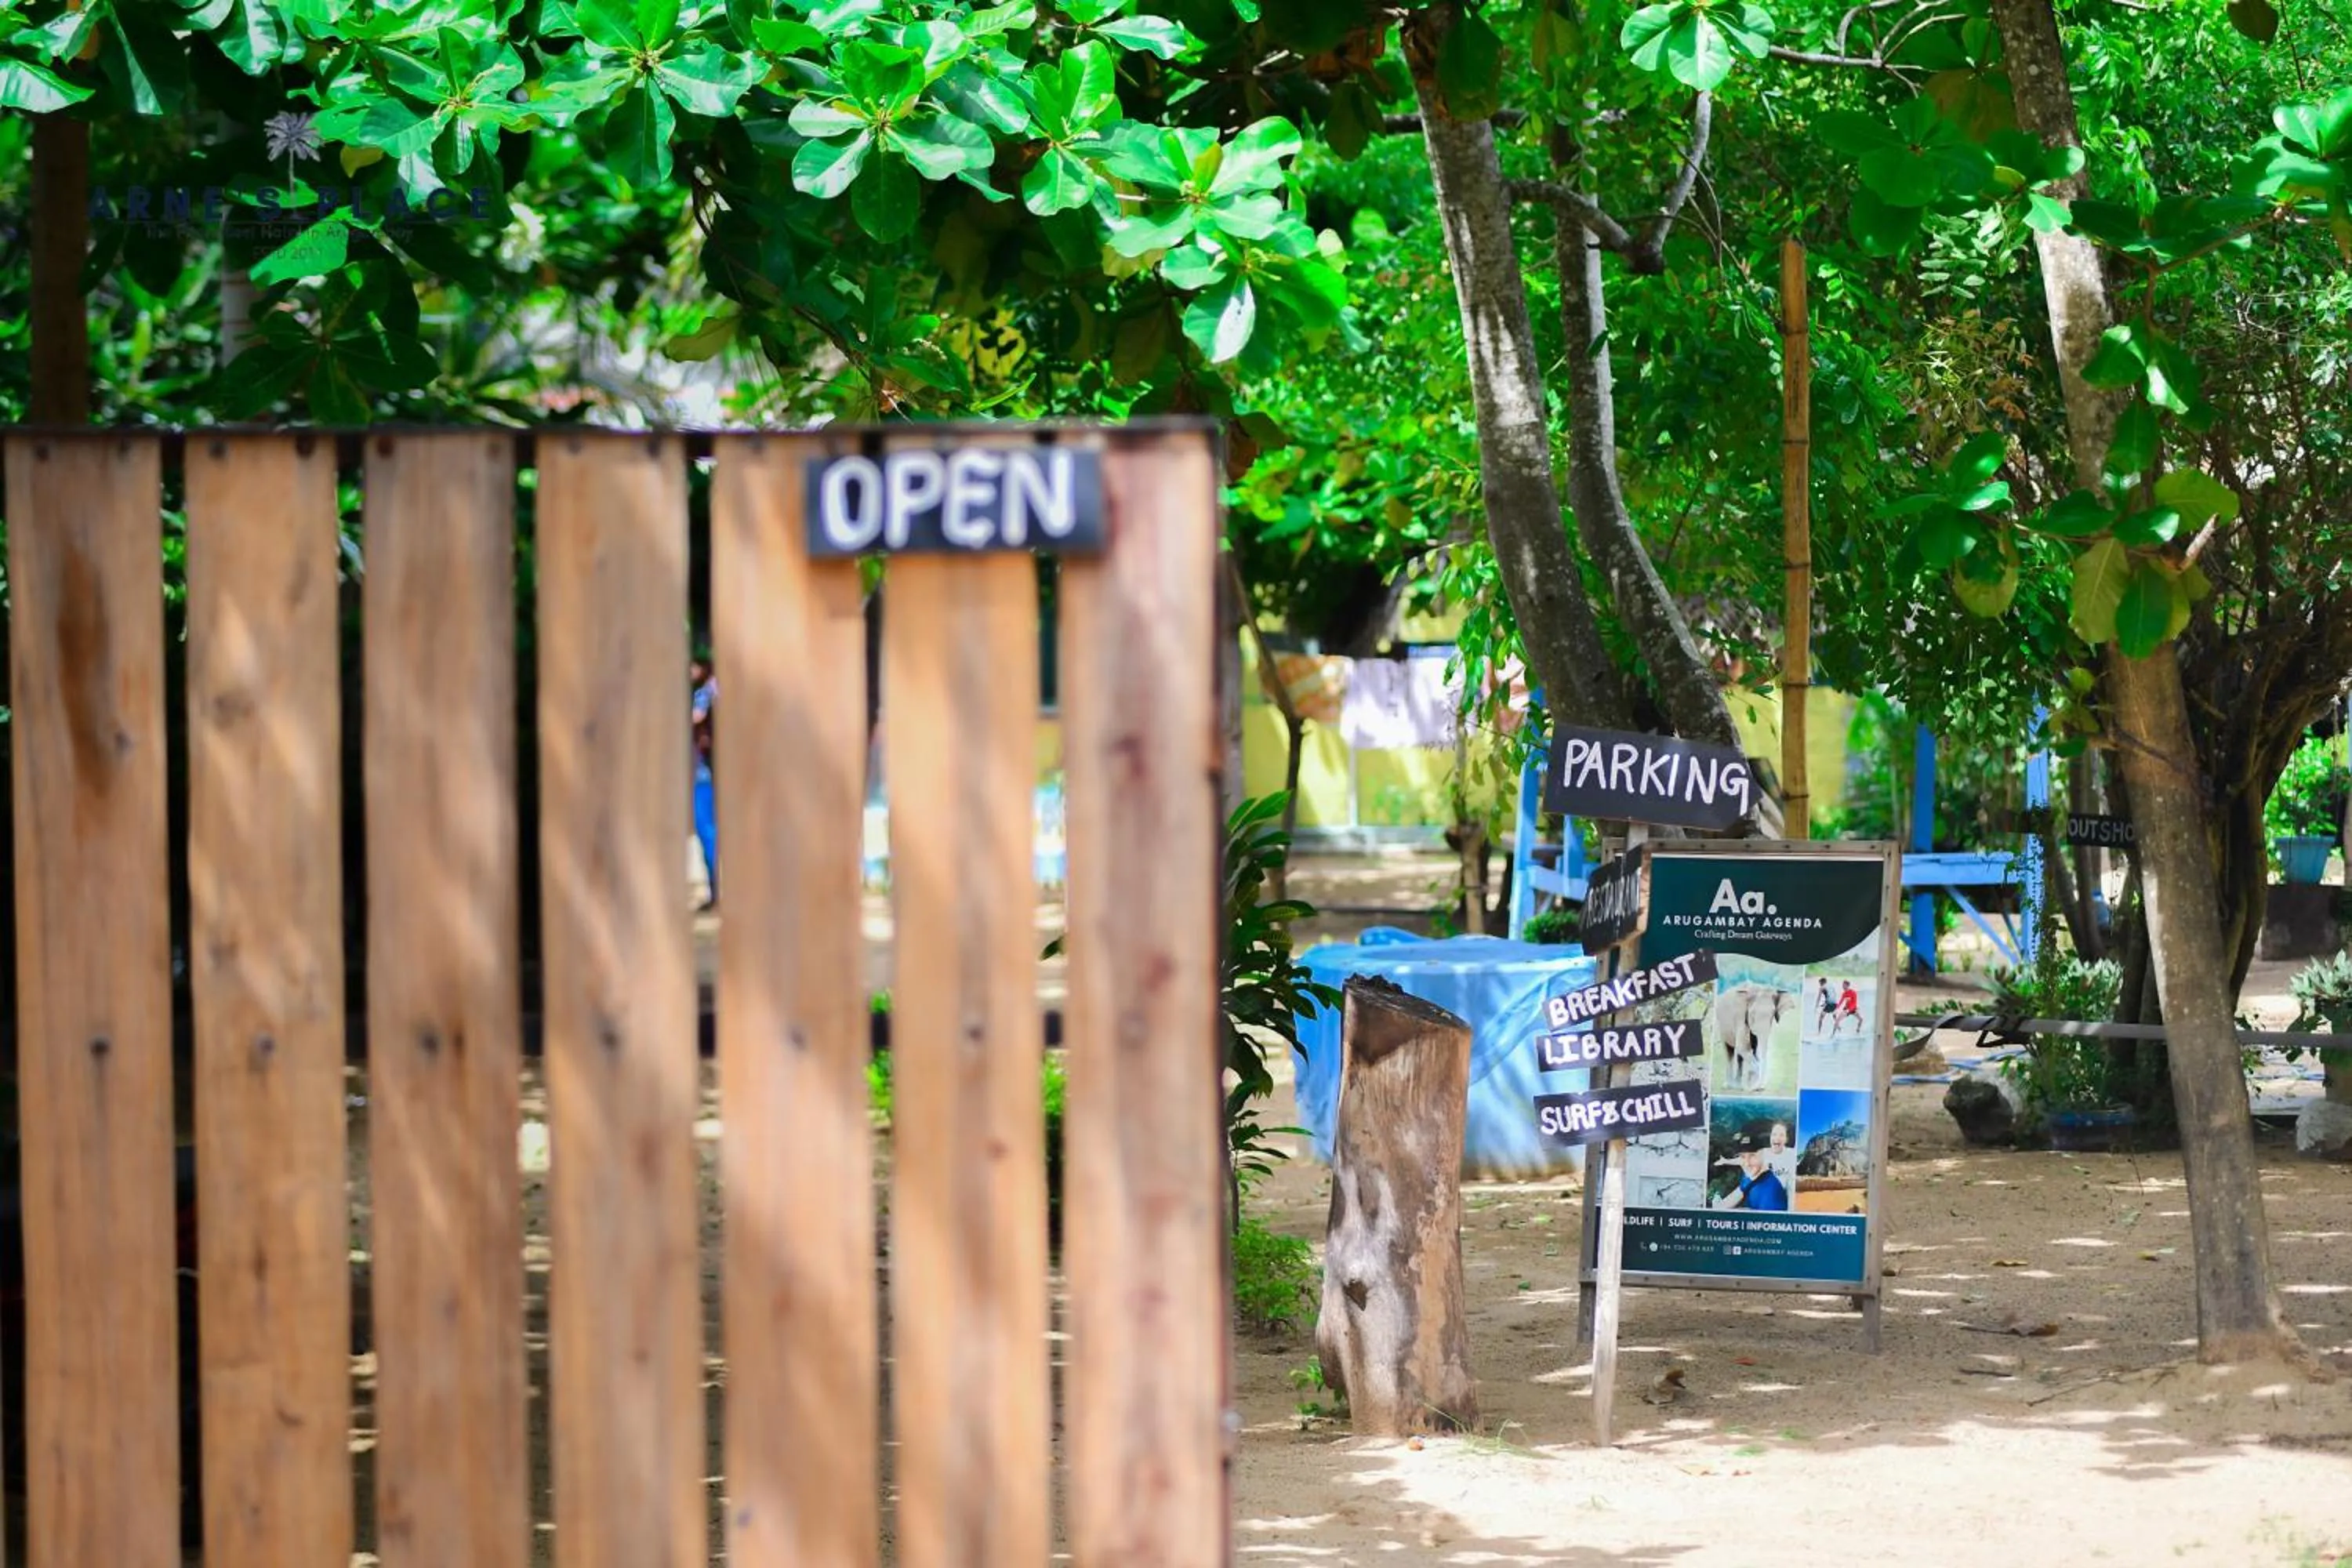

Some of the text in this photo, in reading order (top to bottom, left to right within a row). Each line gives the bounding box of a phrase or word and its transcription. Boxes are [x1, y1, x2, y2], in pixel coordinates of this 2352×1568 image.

[821, 448, 1076, 550] OPEN
[1563, 739, 1749, 816] PARKING
[1709, 877, 1777, 915] Aa.
[1663, 915, 1822, 928] ARUGAMBAY AGENDA
[1694, 929, 1726, 940] Crafting
[1549, 953, 1695, 1027] BREAKFAST
[1544, 1024, 1686, 1065] LIBRARY
[1668, 1218, 1692, 1227] SURF
[1705, 1219, 1738, 1229] TOURS
[1747, 1221, 1817, 1233] INFORMATION
[1819, 1224, 1857, 1235] CENTER
